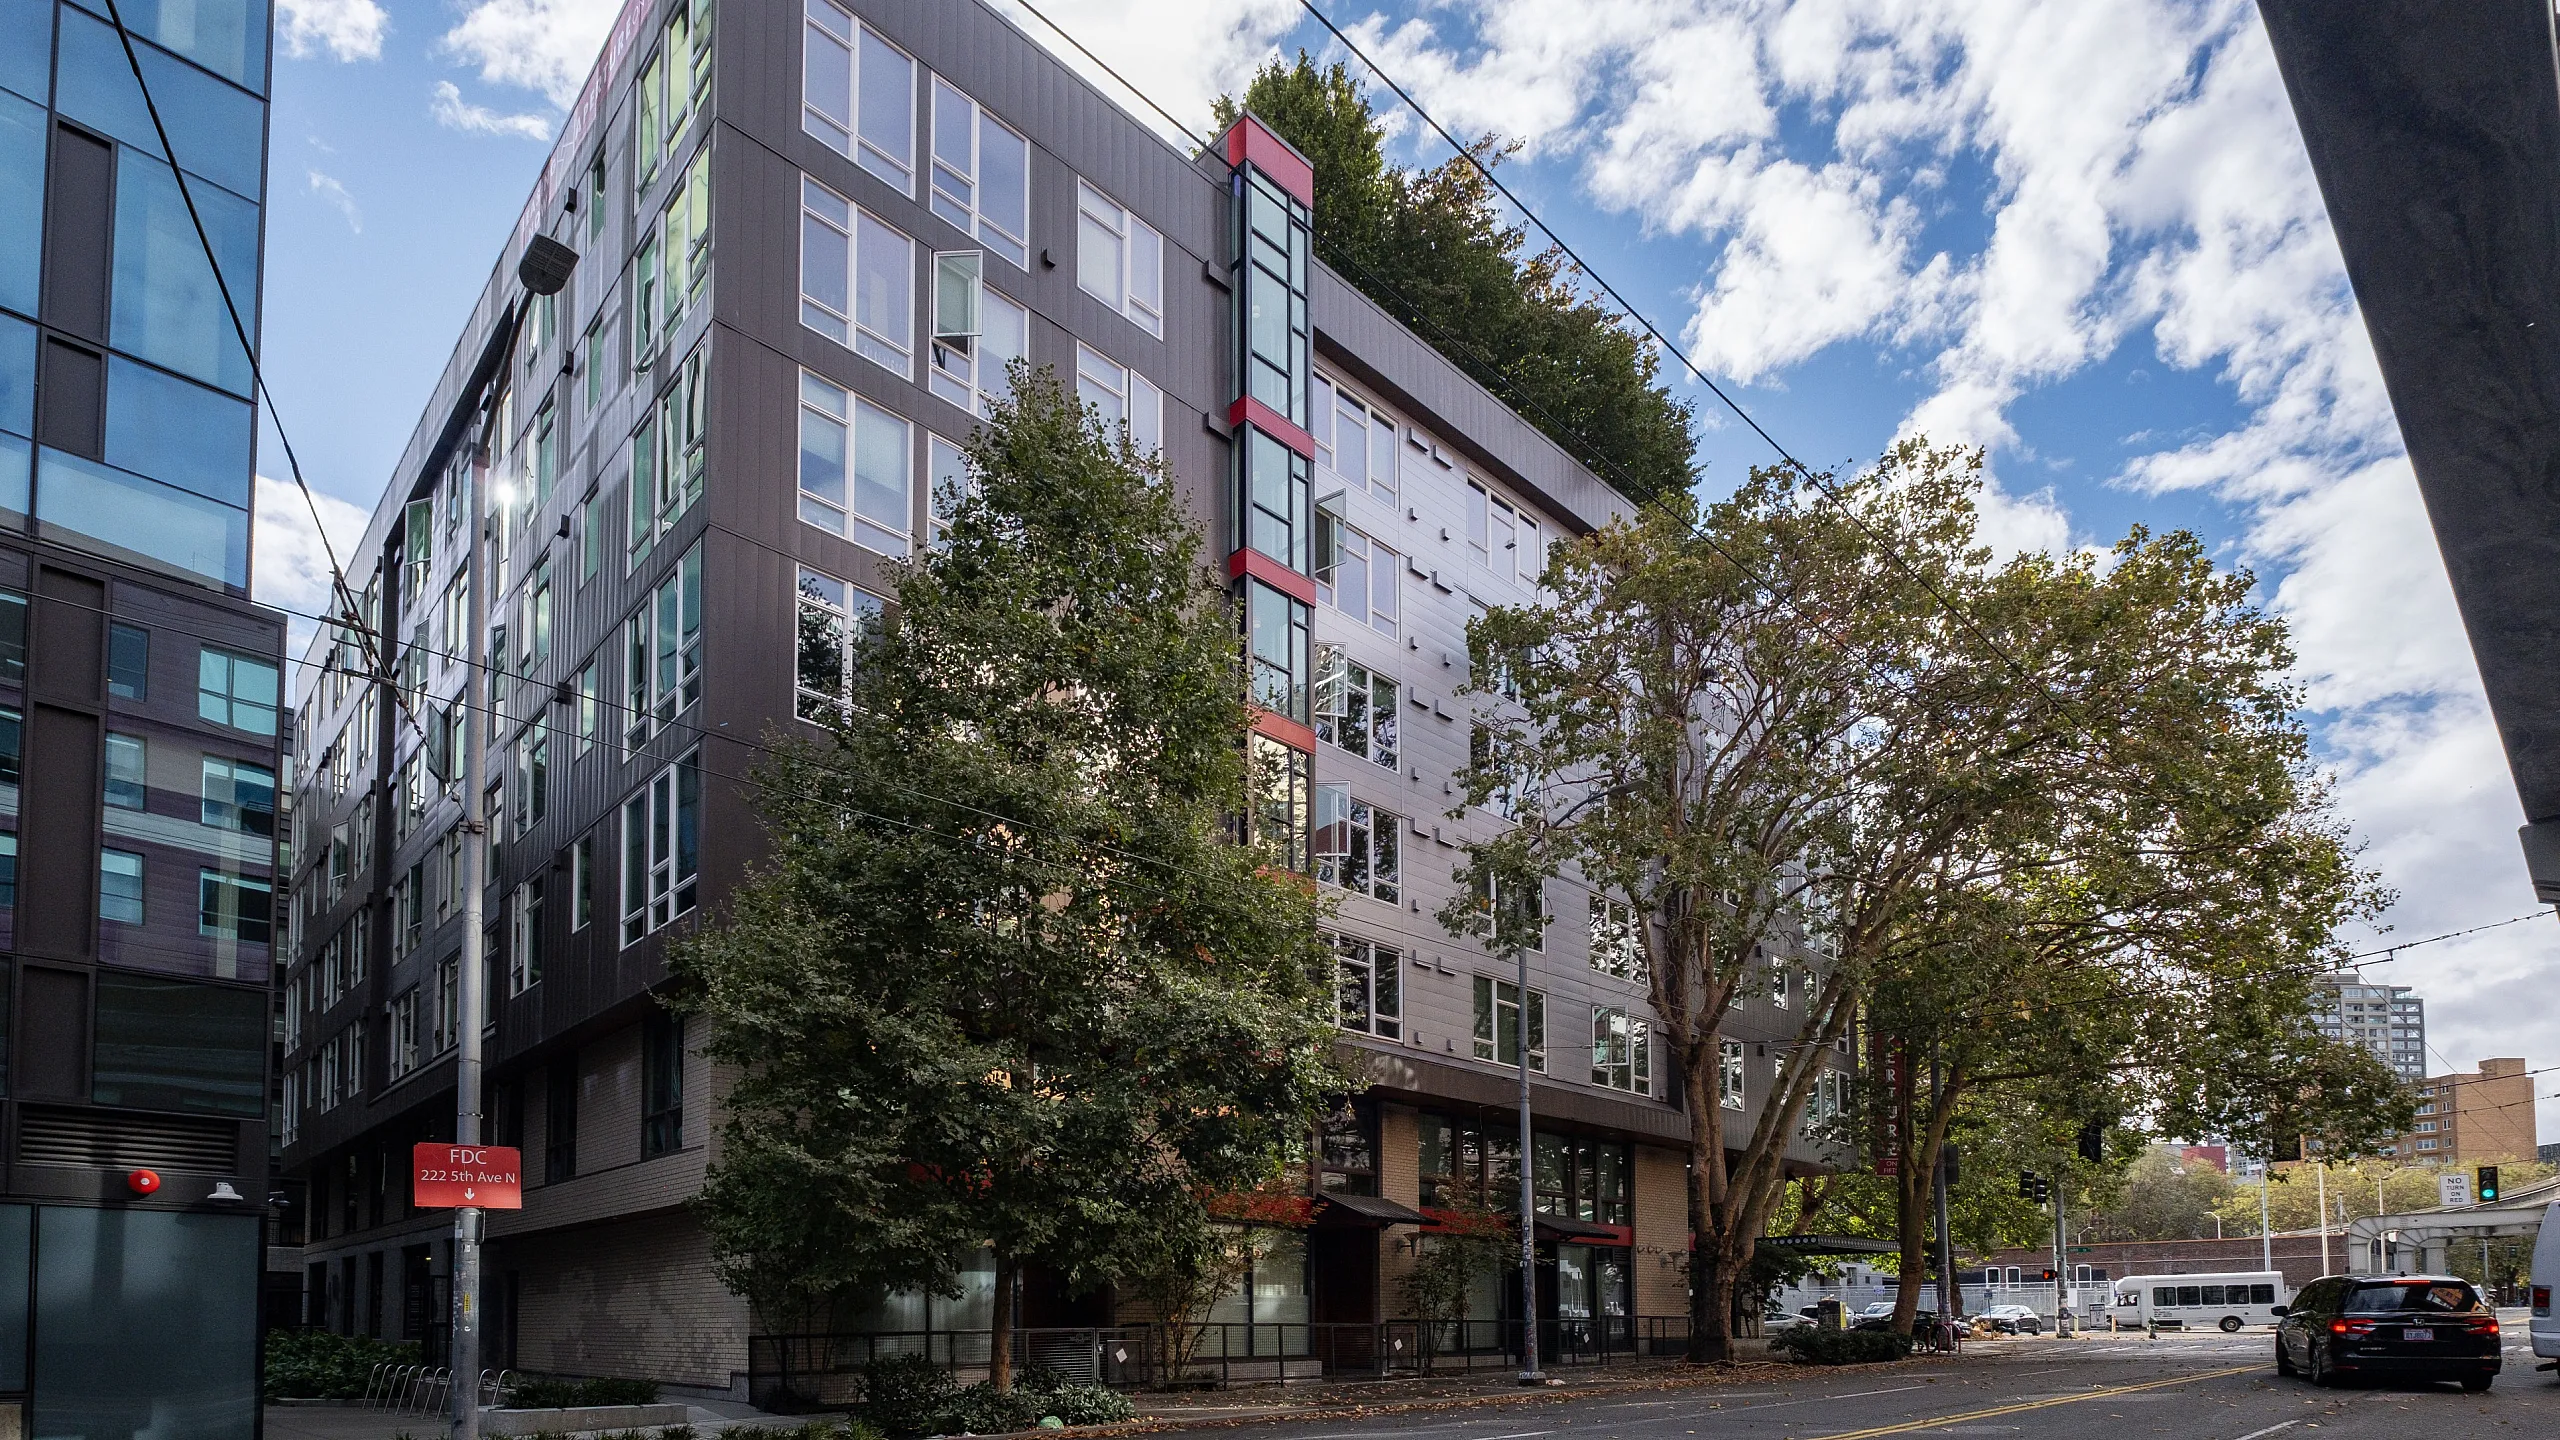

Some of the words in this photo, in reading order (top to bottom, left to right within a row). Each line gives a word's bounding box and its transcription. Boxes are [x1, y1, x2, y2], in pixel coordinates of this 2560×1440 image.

[574, 14, 632, 141] APERTURE
[1886, 1033, 1897, 1156] ERTURE
[421, 1169, 447, 1181] 222
[450, 1170, 474, 1182] 5th
[477, 1171, 502, 1183] Ave
[505, 1172, 516, 1184] N
[450, 1149, 487, 1165] FDC
